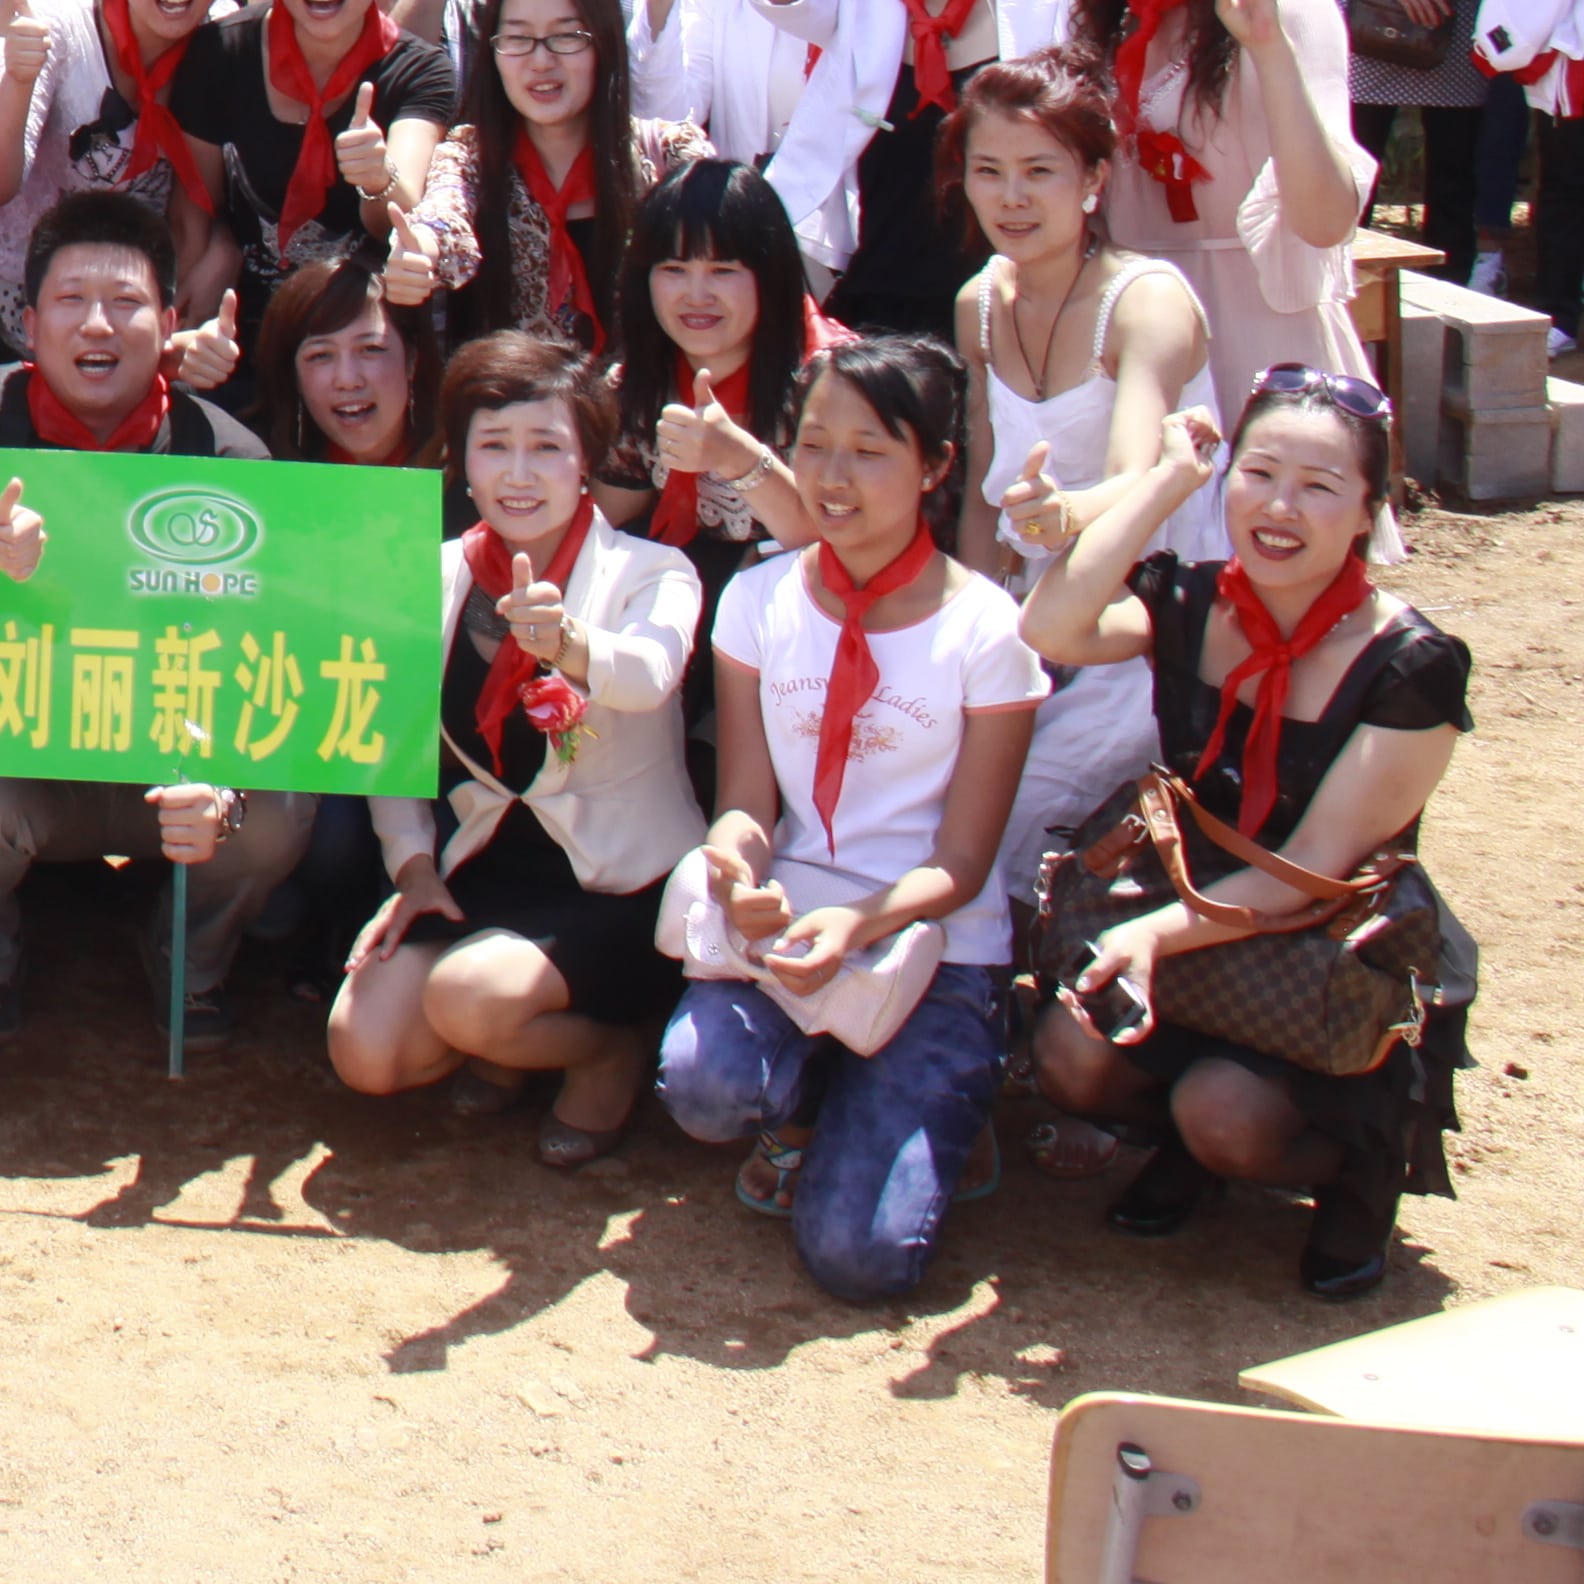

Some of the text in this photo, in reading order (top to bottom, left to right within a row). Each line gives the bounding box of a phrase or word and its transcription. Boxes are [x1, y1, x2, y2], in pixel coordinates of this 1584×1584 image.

[129, 568, 258, 596] SUN HOPE
[872, 685, 939, 730] Ladies
